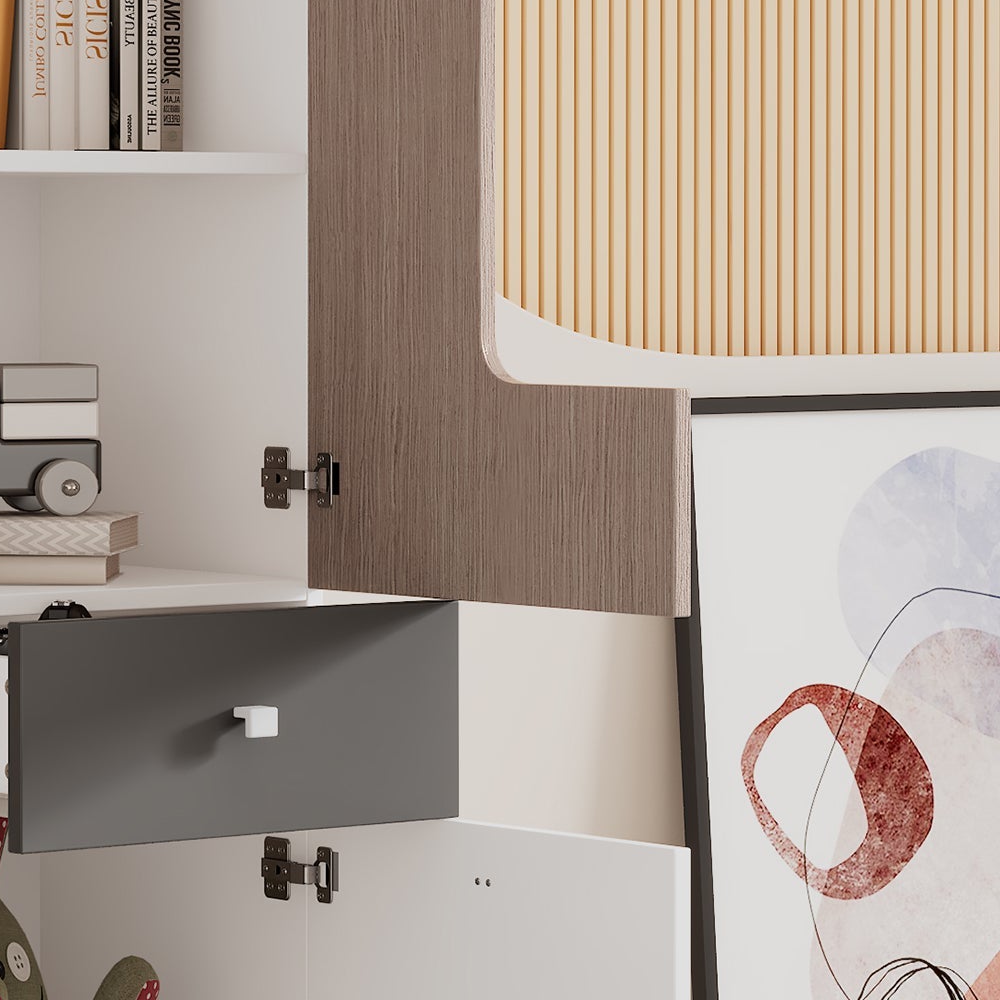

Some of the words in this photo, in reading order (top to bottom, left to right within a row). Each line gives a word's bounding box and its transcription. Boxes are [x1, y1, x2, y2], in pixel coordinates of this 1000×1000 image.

[147, 39, 157, 57] OF
[147, 59, 157, 107] ALLURE
[147, 109, 157, 136] THE
